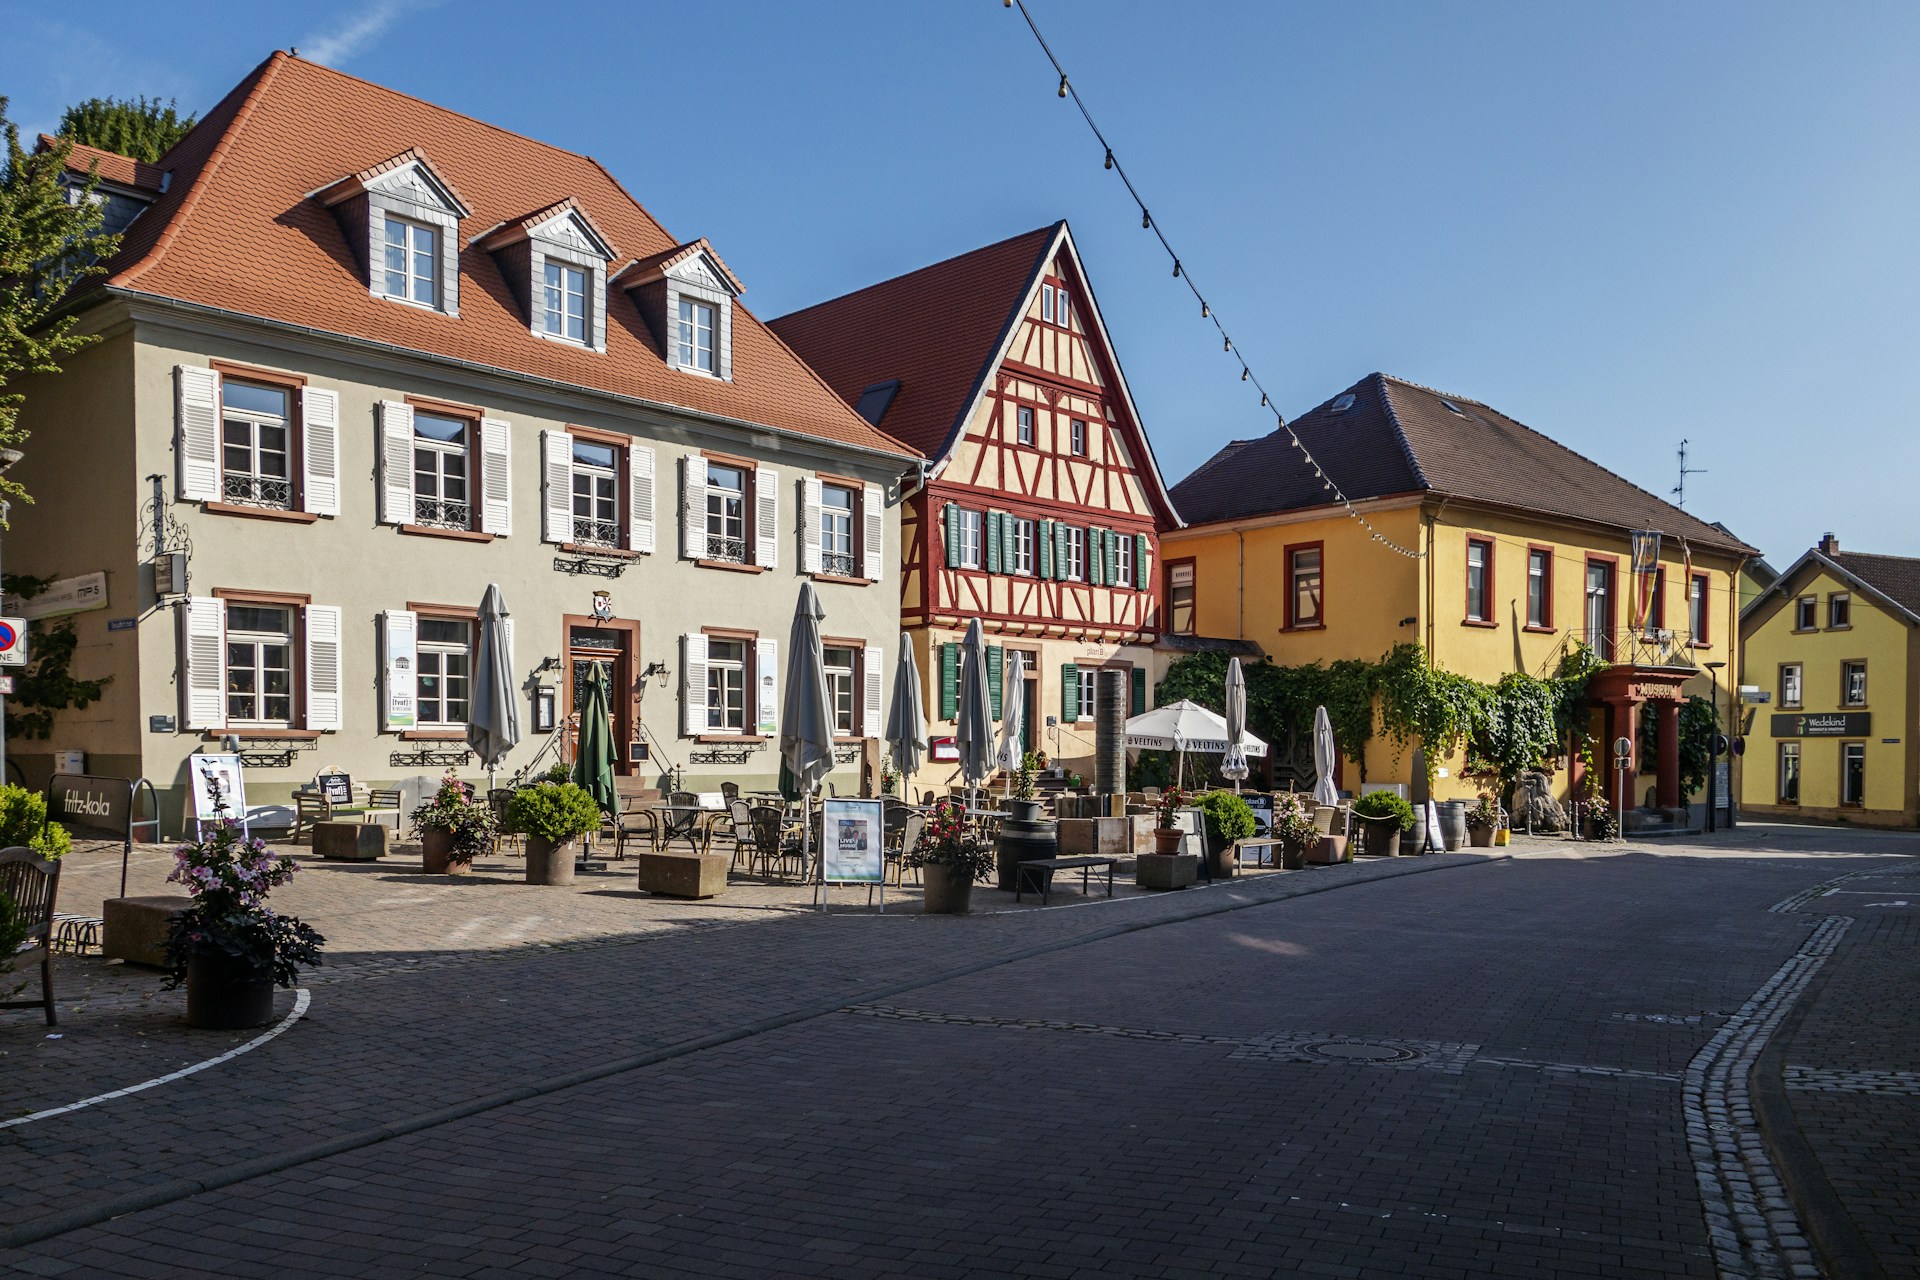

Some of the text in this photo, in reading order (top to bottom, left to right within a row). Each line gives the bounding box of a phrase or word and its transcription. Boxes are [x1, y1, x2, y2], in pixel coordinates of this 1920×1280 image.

[1640, 683, 1678, 696] MUSEUM
[1808, 715, 1846, 727] Wedekind
[1134, 737, 1162, 747] VELTINS
[1193, 740, 1225, 750] VELTINS
[64, 788, 111, 817] fritz-kola
